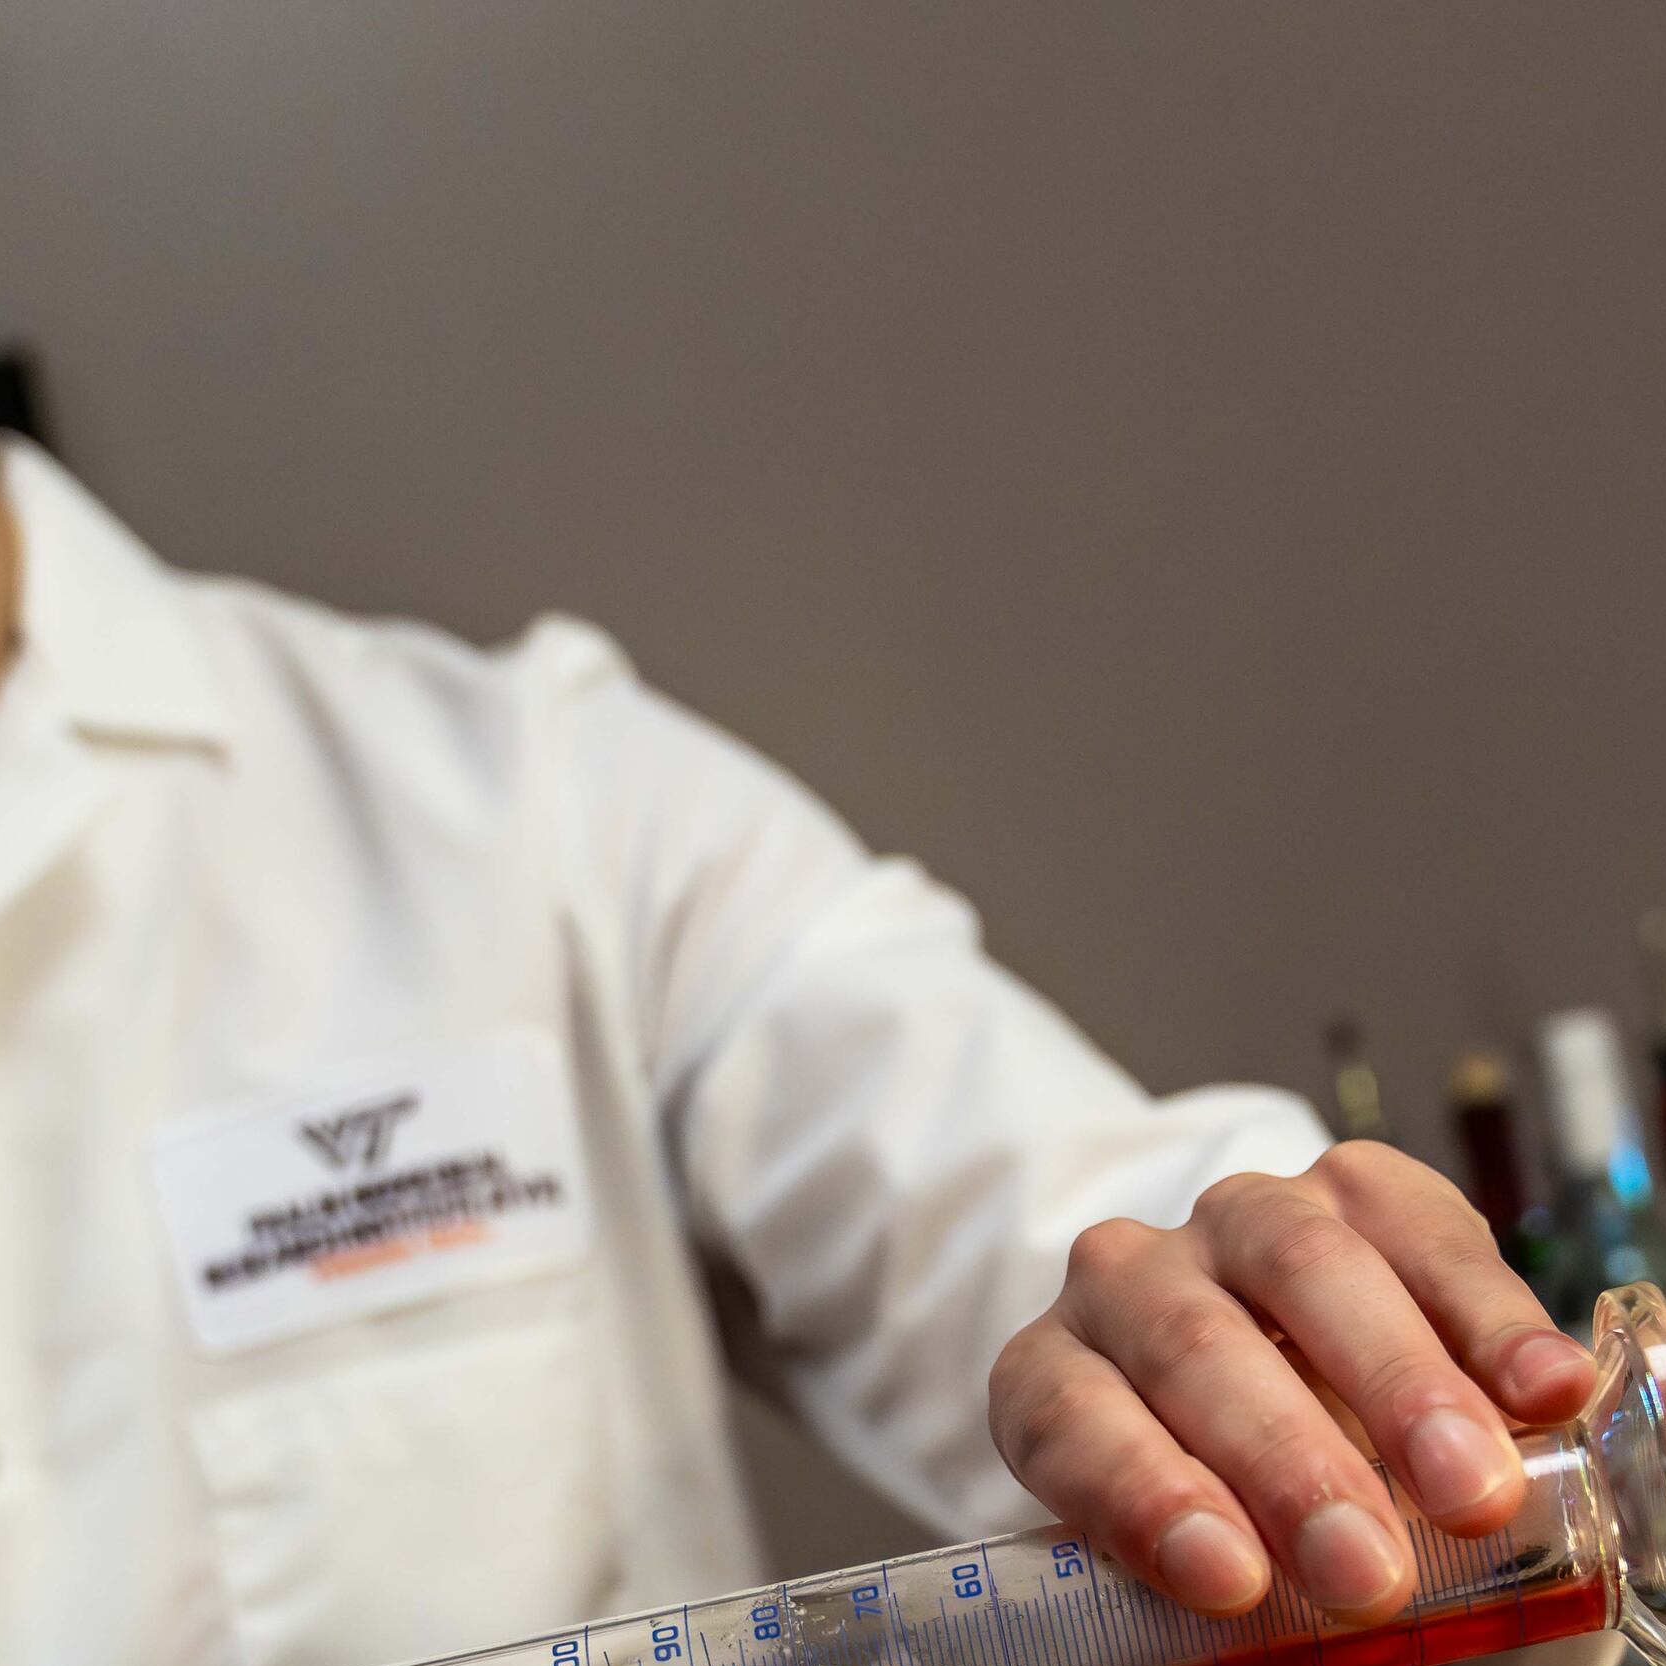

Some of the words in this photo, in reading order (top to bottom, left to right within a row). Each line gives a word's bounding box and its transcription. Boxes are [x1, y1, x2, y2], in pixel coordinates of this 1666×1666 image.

[1051, 1541, 1084, 1579] 50
[951, 1563, 983, 1599] 60
[852, 1585, 884, 1621] 70
[751, 1605, 782, 1641] 80
[652, 1625, 682, 1662] 90
